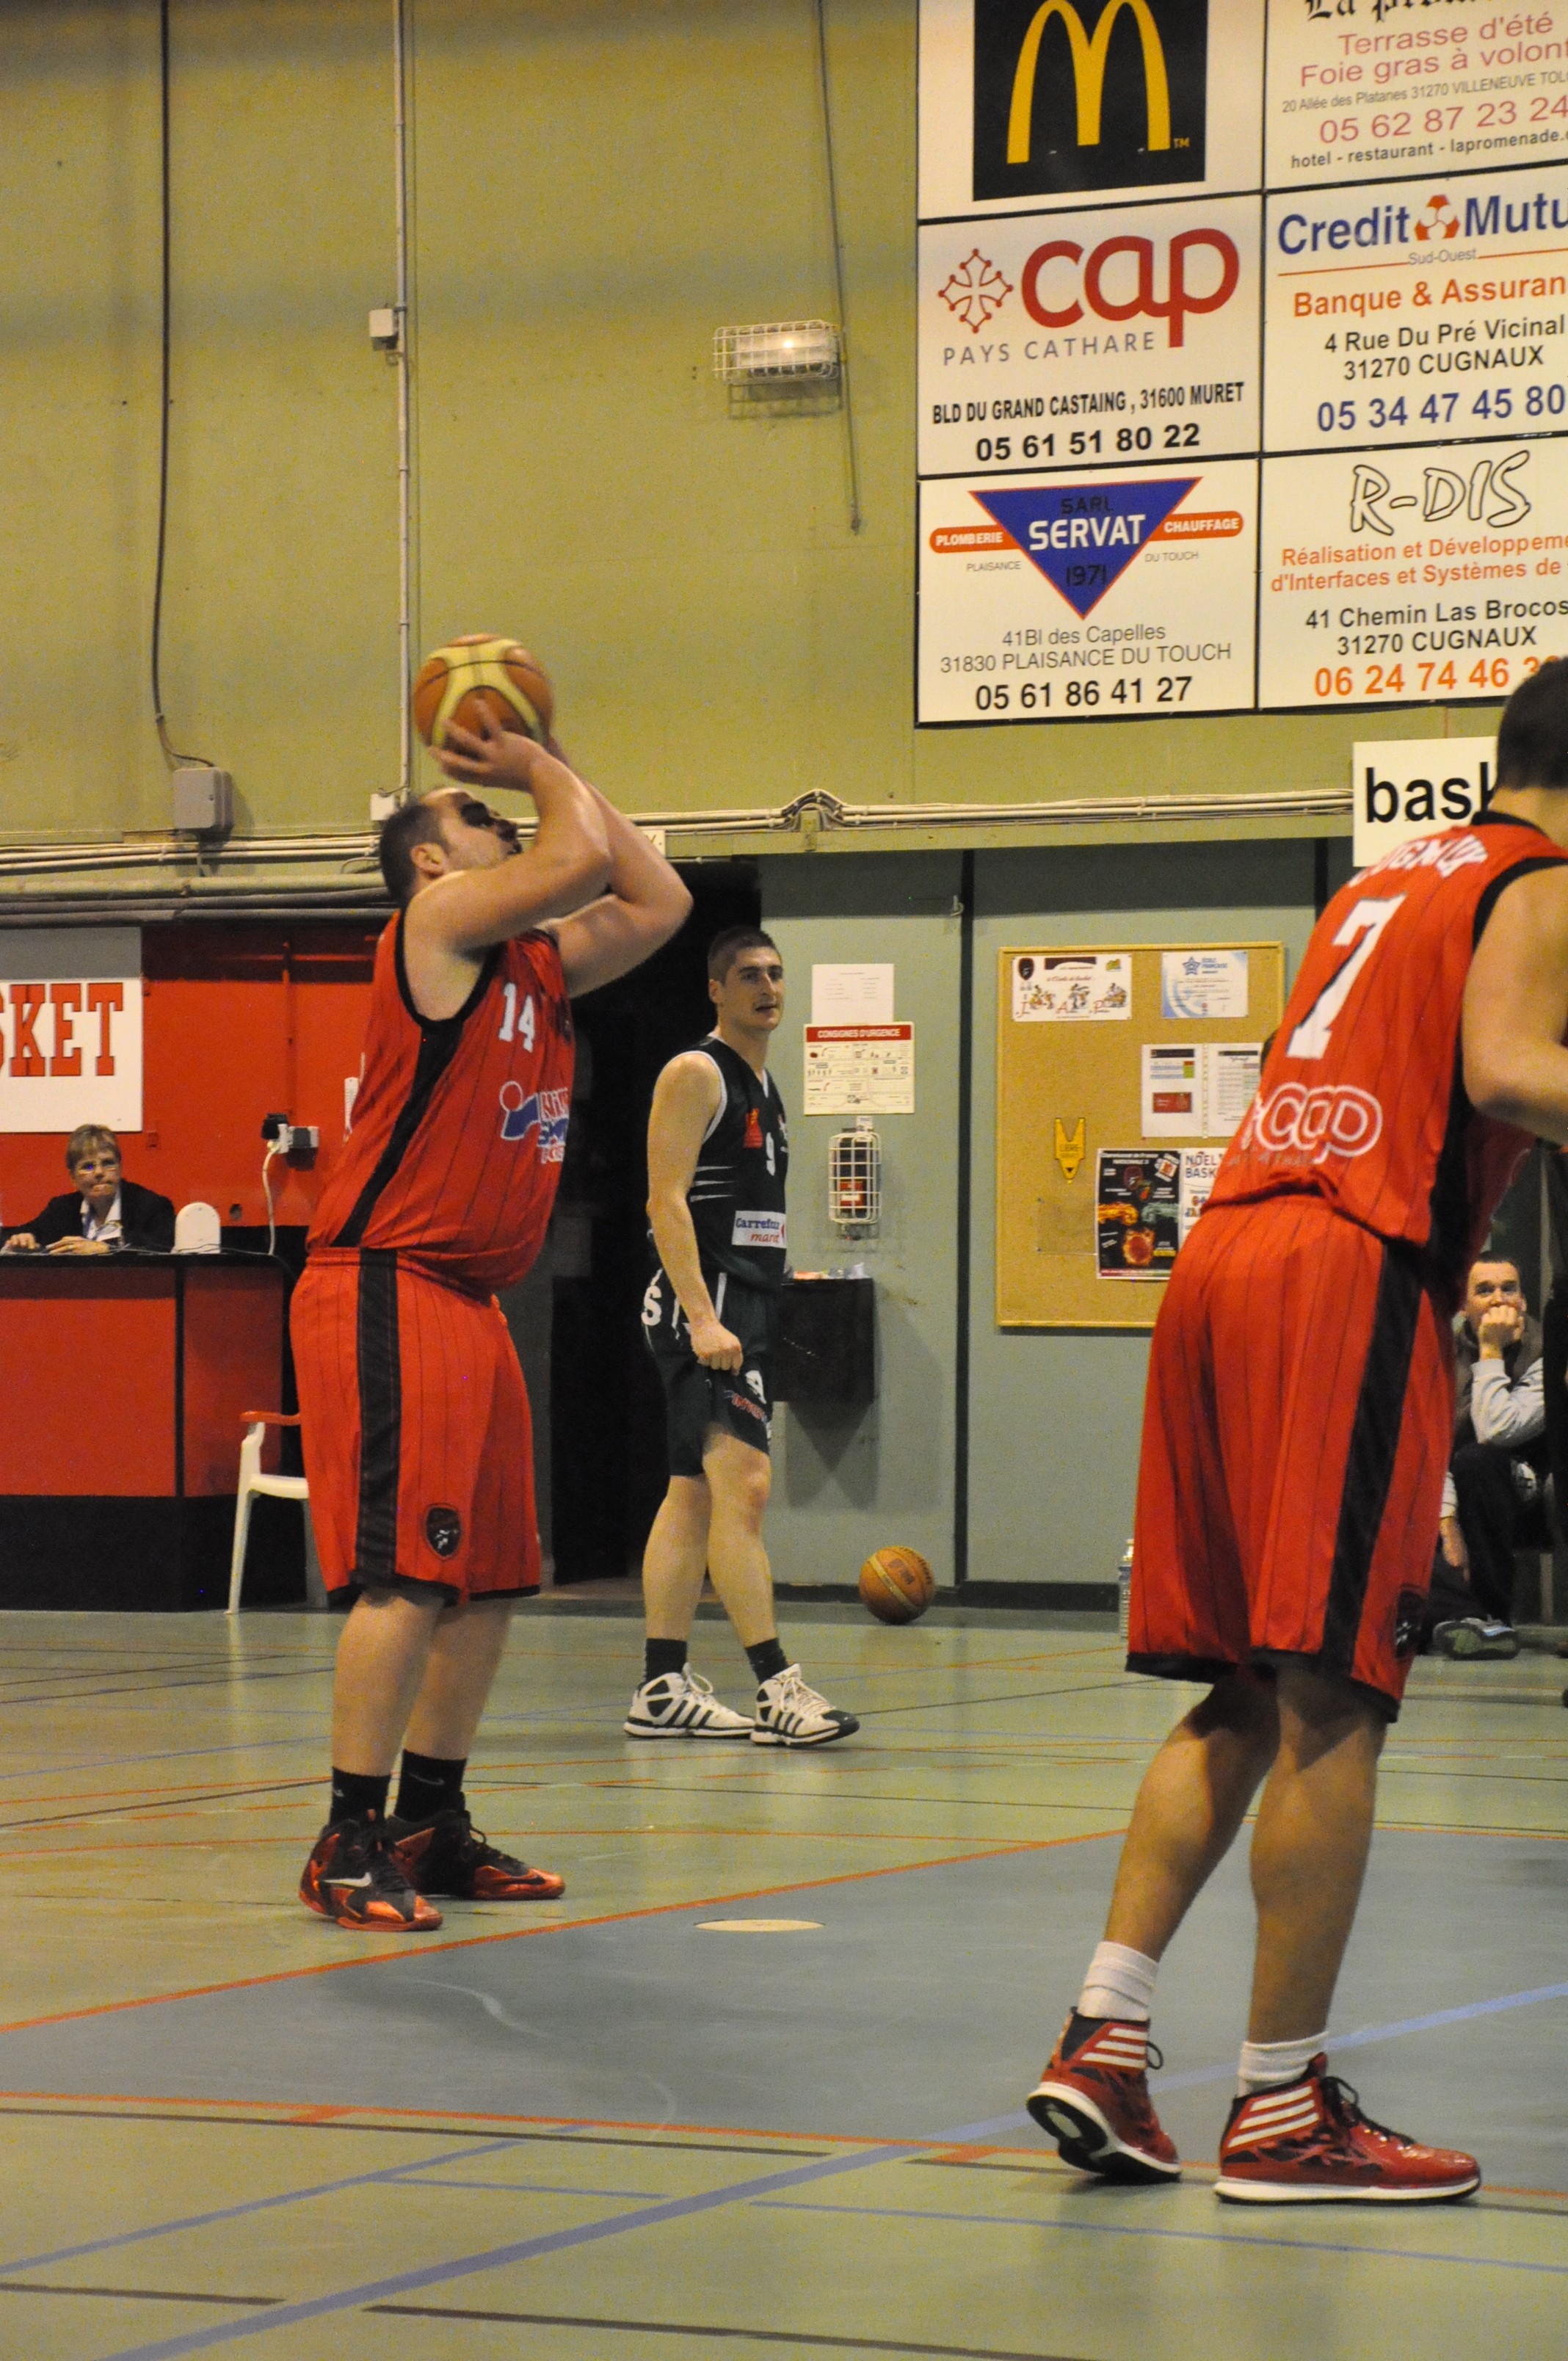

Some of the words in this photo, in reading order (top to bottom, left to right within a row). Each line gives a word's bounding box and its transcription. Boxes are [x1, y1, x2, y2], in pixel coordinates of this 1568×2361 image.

[1339, 26, 1468, 56] Terrasse
[1478, 12, 1554, 40] d'été
[1300, 63, 1362, 87] Foie
[1373, 55, 1441, 85] gras
[1451, 48, 1468, 70] à
[1282, 99, 1296, 112] 20
[1299, 95, 1328, 112] Allée
[1330, 93, 1352, 107] des
[1355, 87, 1408, 105] Platanes
[1411, 81, 1449, 99] 31270
[1452, 73, 1536, 95] VILLENEUVE
[1539, 70, 1568, 85] TOL
[1320, 117, 1359, 144] 05
[1371, 112, 1412, 138] 62
[1424, 106, 1464, 133] 87
[1477, 101, 1517, 128] 23
[1529, 95, 1568, 122] 24
[1291, 152, 1331, 169] hotel
[1348, 142, 1434, 163] restaurant
[1278, 204, 1411, 255] Credit
[1408, 248, 1478, 266] Sud-Ouest
[1021, 228, 1240, 349] cap
[1293, 289, 1401, 317] Banque
[1412, 281, 1432, 307] &
[1442, 275, 1567, 304] Assuran
[943, 342, 1010, 366] PAYS
[1024, 330, 1156, 360] CATHARE
[1324, 333, 1337, 352] 4
[1345, 331, 1390, 352] Rue
[1398, 327, 1429, 347] Du
[1438, 320, 1476, 344] Pré
[1484, 314, 1566, 341] Vicinal
[1344, 356, 1410, 380] 31270
[1419, 345, 1545, 374] CUGNAUX
[933, 403, 961, 424] BLD
[966, 402, 987, 422] DU
[992, 396, 1045, 421] GRAND
[1050, 390, 1126, 416] CASTAING
[1139, 386, 1186, 410] 31600
[1190, 381, 1245, 405] MURET
[1318, 401, 1357, 432] 05
[1368, 396, 1408, 429] 34
[1420, 393, 1460, 424] 47
[1472, 388, 1513, 420] 45
[1525, 384, 1567, 416] 80
[976, 436, 1011, 462] 05
[1023, 433, 1056, 458] 61
[1070, 429, 1102, 455] 51
[1117, 427, 1152, 452] 80
[1164, 423, 1200, 449] 22
[1061, 496, 1114, 515] SARL
[1351, 450, 1532, 536] R-DIS
[934, 531, 1004, 548] PLOMBERIE
[1029, 514, 1147, 551] SERVAT
[1164, 518, 1239, 534] CHAUFFAGE
[967, 561, 1021, 573] PLAISANCE
[1144, 553, 1159, 563] DU
[1162, 550, 1199, 562] TOUCH
[1282, 543, 1396, 566] Réalisation
[1403, 542, 1423, 559] et
[1066, 565, 1107, 587] 1971
[1271, 570, 1390, 592] d'Interfaces
[1398, 565, 1416, 584] et
[1422, 561, 1527, 586] Systèmes
[1535, 557, 1562, 576] de
[1306, 609, 1330, 629] 41
[1340, 604, 1427, 628] Chemin
[1436, 602, 1476, 623] Las
[1486, 599, 1568, 620] Brocos
[1048, 627, 1081, 645] des
[1086, 624, 1166, 646] Capelles
[1337, 634, 1404, 656] 31270
[1412, 625, 1538, 652] CUGNAUX
[940, 654, 996, 673] 31830
[1003, 648, 1115, 671] PLAISANCE
[1121, 645, 1150, 664] DU
[1157, 642, 1232, 664] TOUCH
[976, 684, 1009, 711] 05
[1021, 682, 1052, 708] 61
[1066, 680, 1100, 707] 86
[1111, 678, 1142, 704] 41
[1157, 676, 1193, 703] 27
[1315, 667, 1353, 697] 06
[1365, 663, 1405, 695] 24
[1417, 660, 1456, 692] 74
[1468, 658, 1510, 689] 46
[1286, 891, 1409, 1061] 7
[0, 982, 123, 1077] KET
[498, 982, 536, 1054] 14
